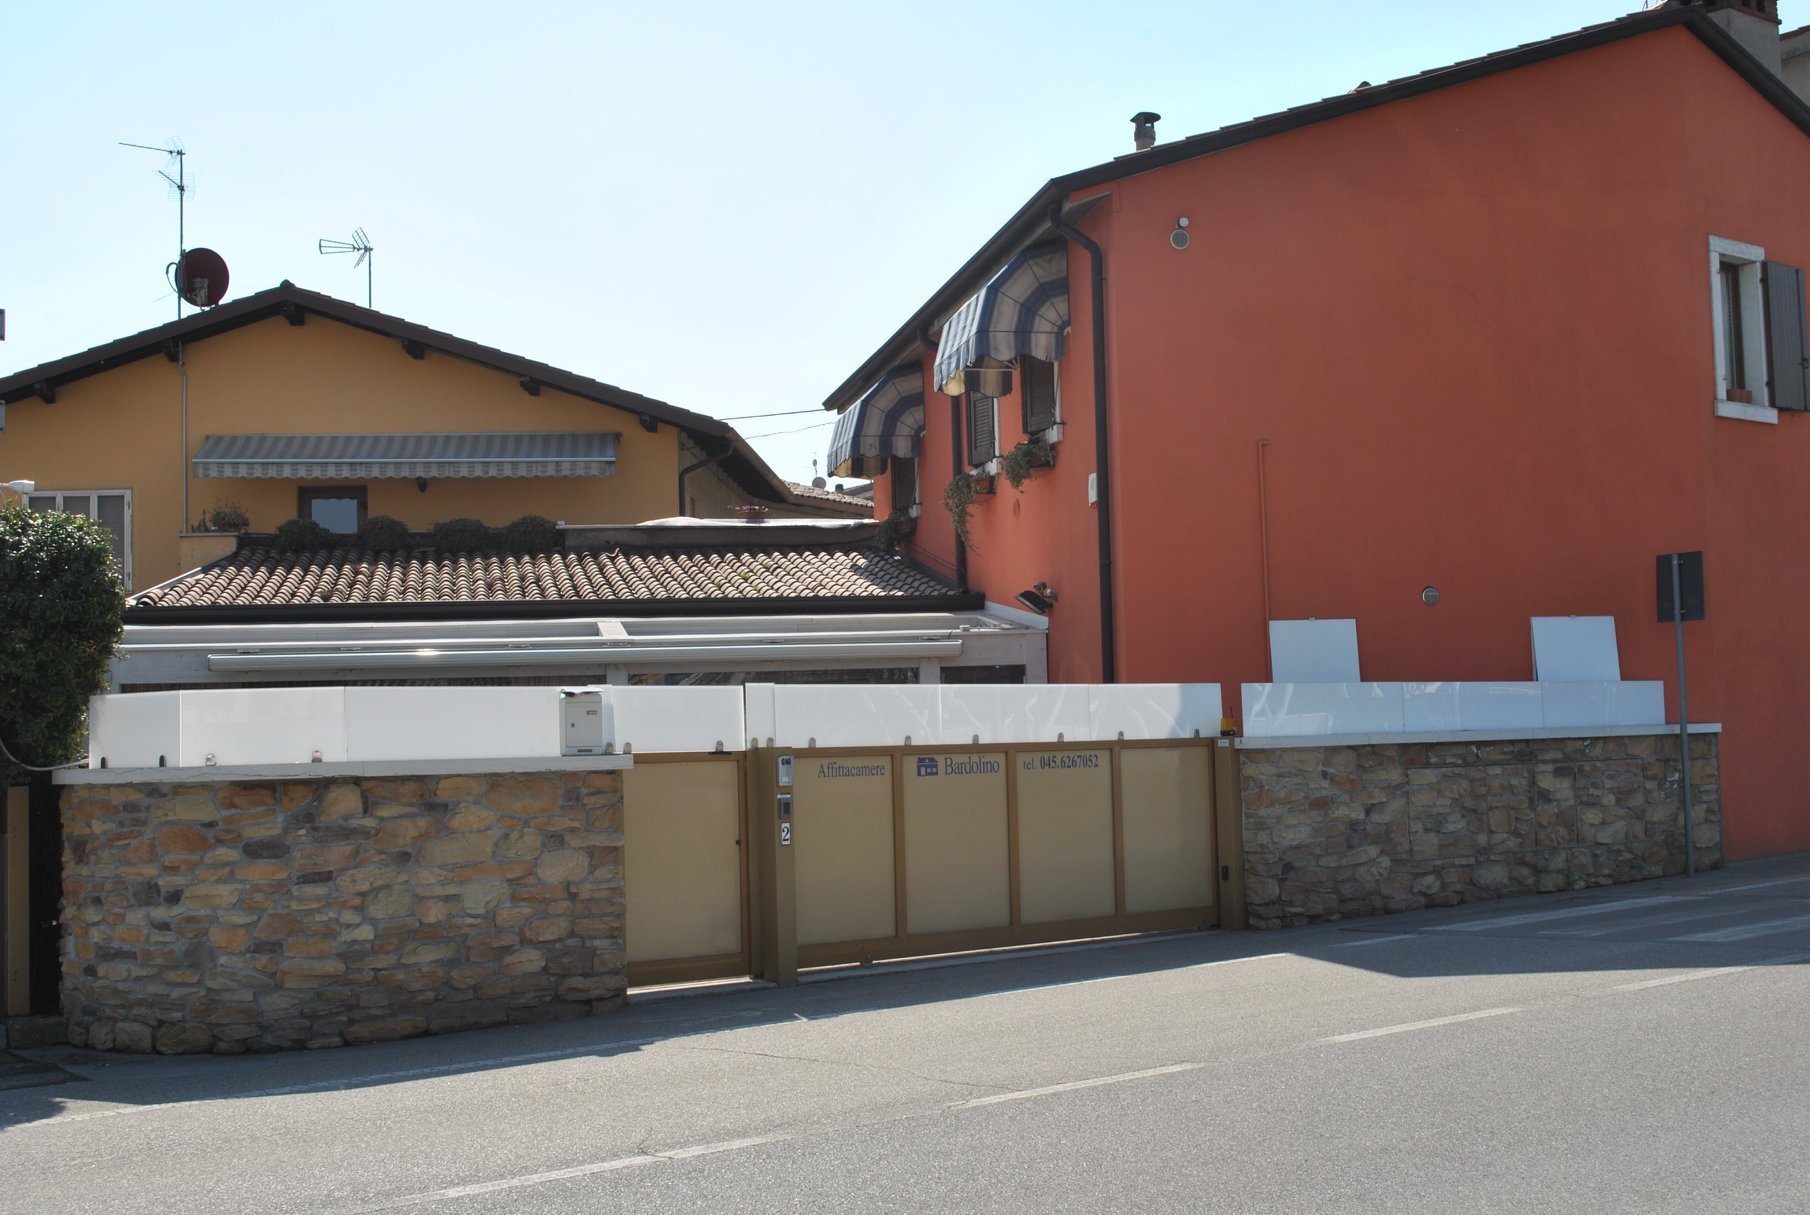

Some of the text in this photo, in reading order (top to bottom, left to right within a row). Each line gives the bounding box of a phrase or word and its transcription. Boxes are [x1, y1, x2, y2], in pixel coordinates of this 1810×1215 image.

[817, 754, 1099, 778] Affittacamere Bardolino tel. 045.6267052
[782, 826, 790, 842] 2
